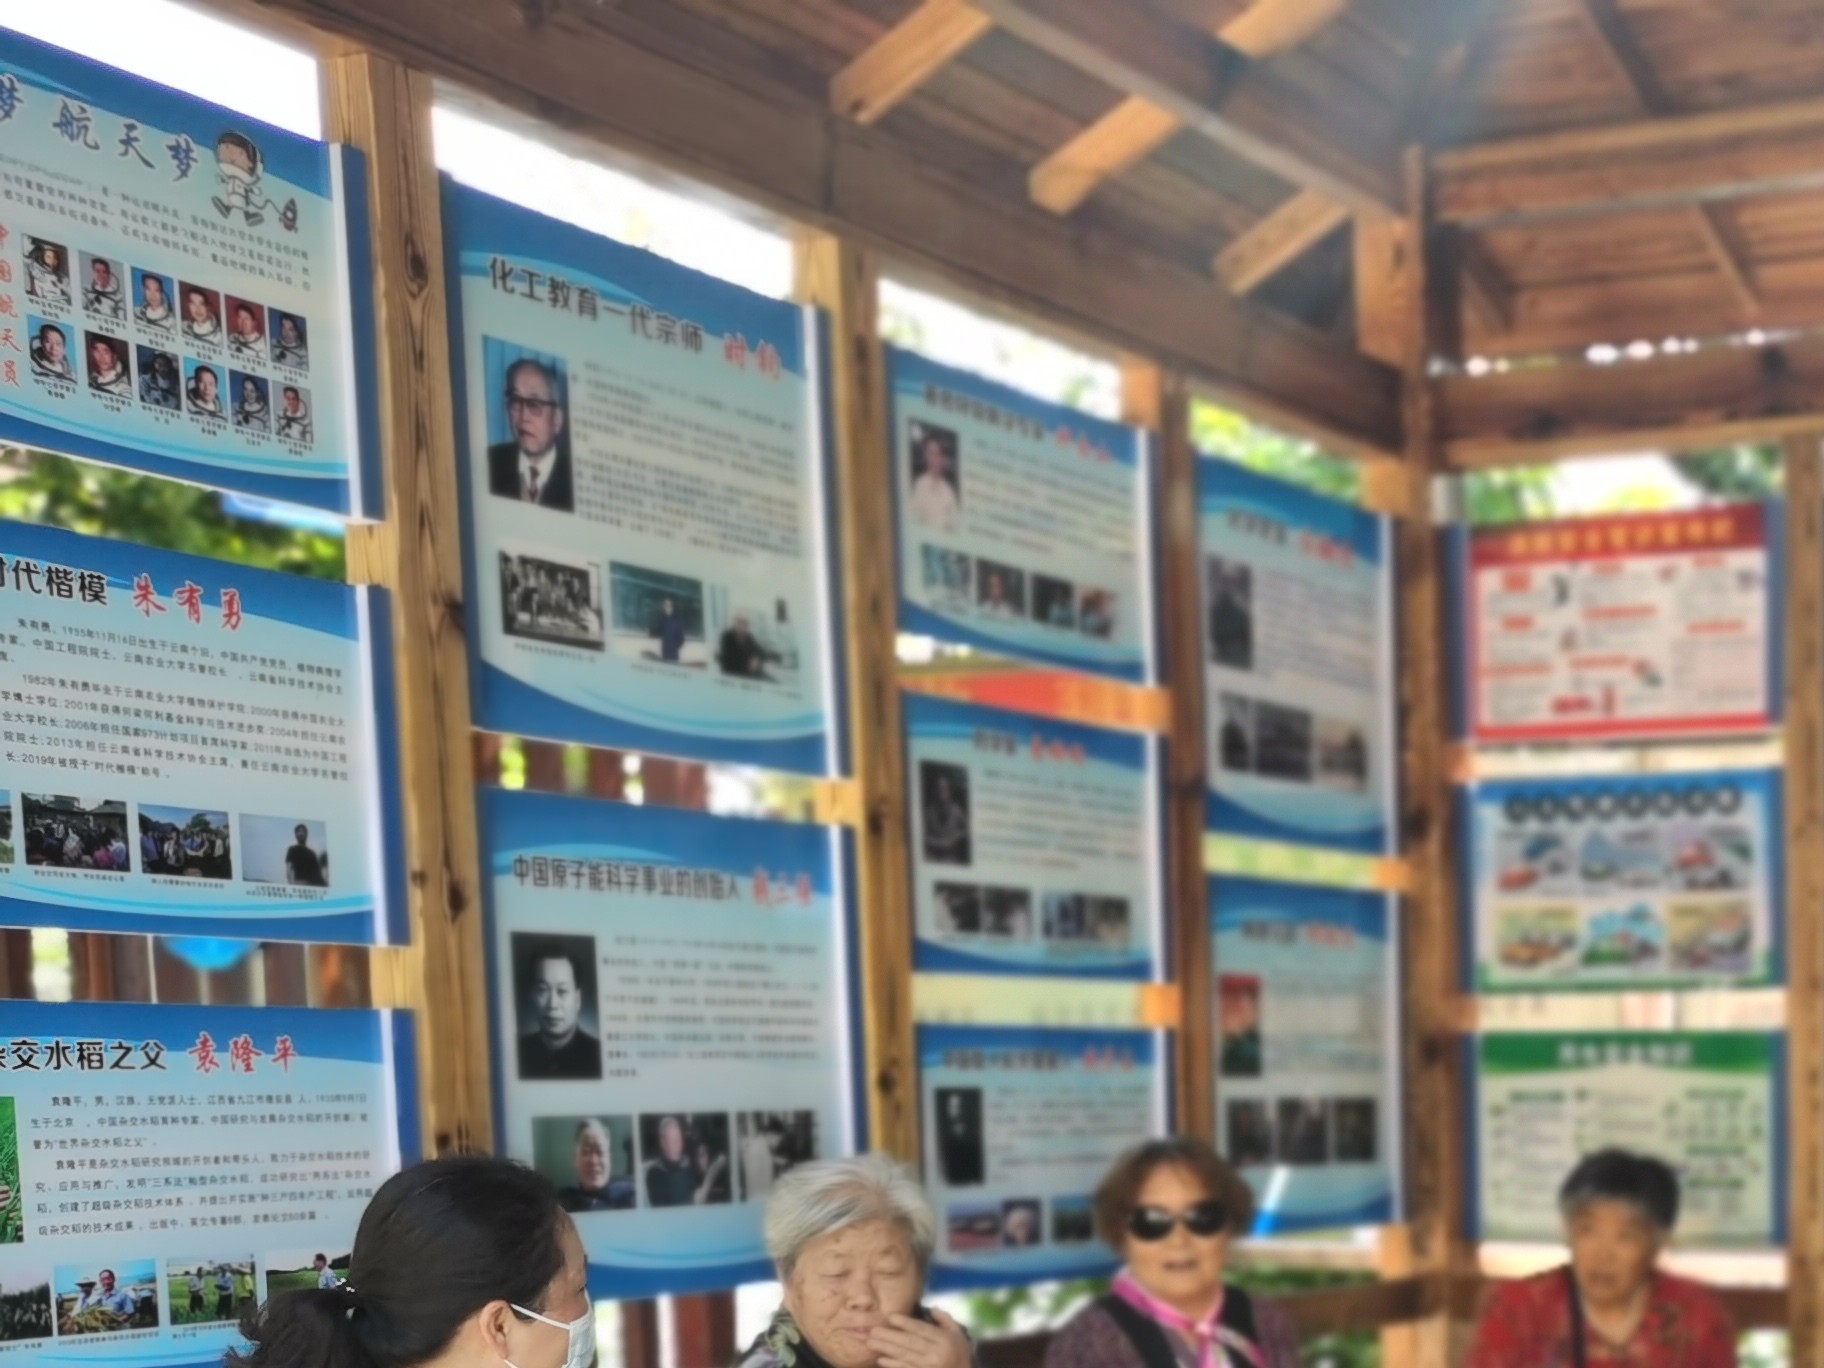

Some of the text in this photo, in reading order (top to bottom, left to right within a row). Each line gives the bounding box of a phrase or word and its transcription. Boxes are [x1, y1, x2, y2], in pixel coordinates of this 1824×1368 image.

[489, 256, 704, 352] 化工教育一代宗师
[133, 575, 241, 630] 朱有勇
[0, 1033, 297, 1073] 交水稻之父 袁隆平
